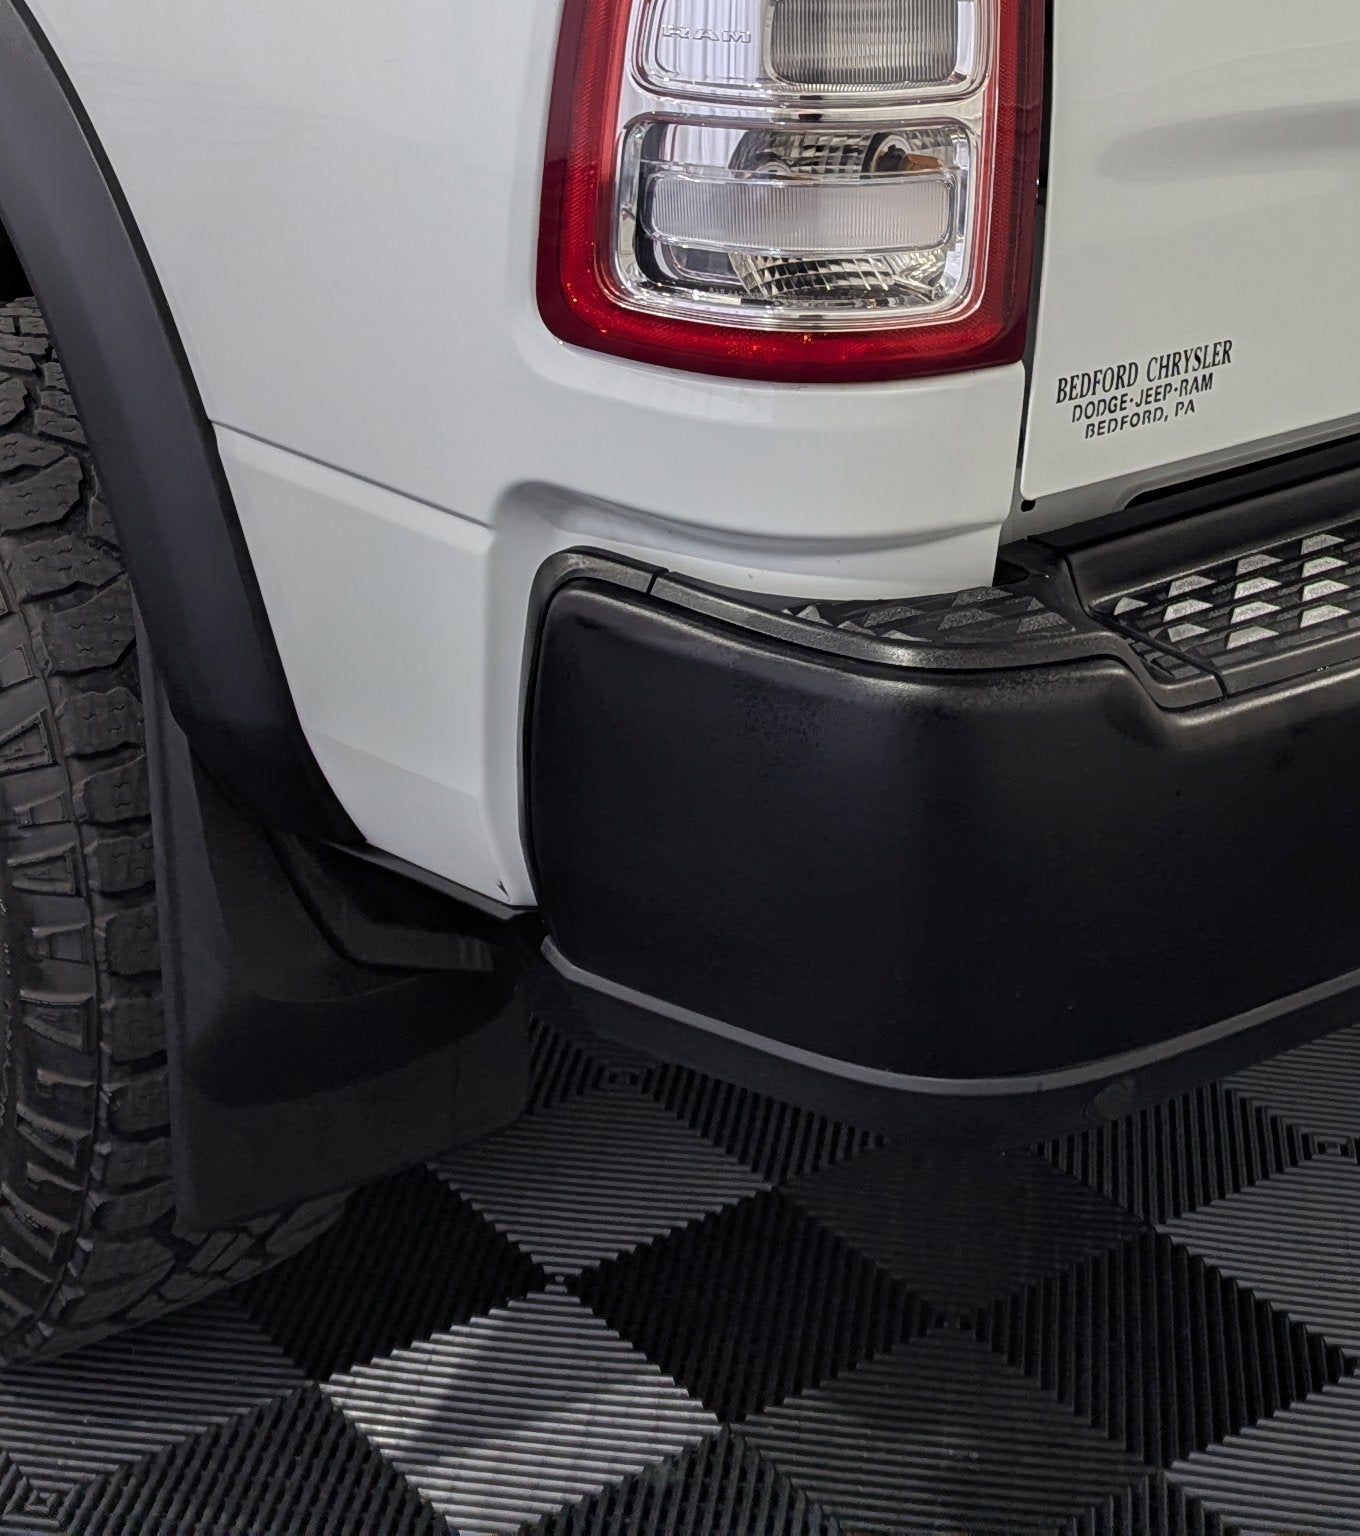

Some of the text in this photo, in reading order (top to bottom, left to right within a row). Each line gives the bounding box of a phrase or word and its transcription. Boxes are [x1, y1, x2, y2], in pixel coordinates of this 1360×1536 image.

[661, 24, 752, 44] RAM
[1056, 340, 1233, 404] BEDFORD CHRYSLER
[1084, 398, 1196, 439] BEDFORD, PA
